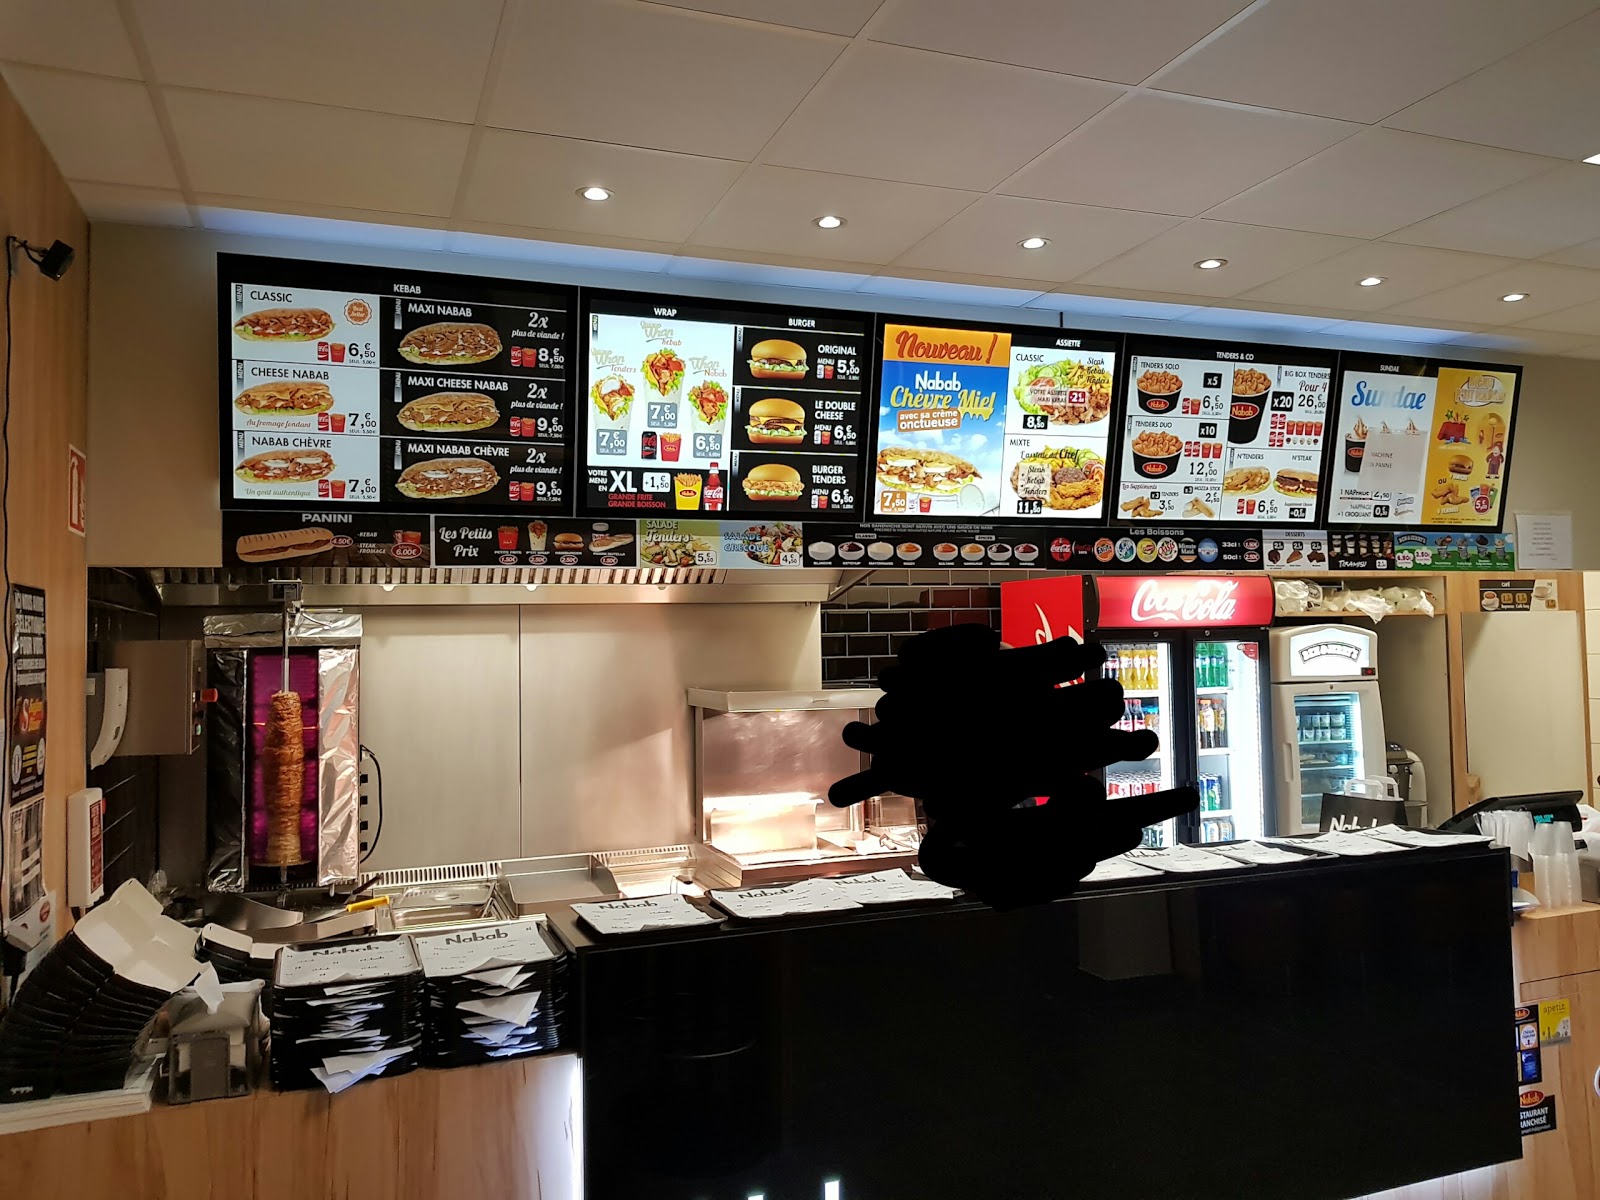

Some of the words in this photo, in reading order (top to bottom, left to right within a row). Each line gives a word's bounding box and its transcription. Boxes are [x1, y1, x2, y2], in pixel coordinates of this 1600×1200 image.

[393, 284, 421, 294] KEBAB
[250, 290, 292, 303] CLASSIC
[408, 303, 434, 315] MAXI
[437, 305, 472, 318] NABAB
[654, 307, 677, 317] WRAP
[788, 318, 816, 328] BURGER
[511, 329, 526, 338] plus
[528, 330, 536, 338] de
[536, 330, 560, 340] viande
[896, 330, 982, 361] Nouveau
[986, 334, 998, 364] !
[1055, 338, 1081, 347] ASSIETTE
[818, 344, 857, 356] ORIGINAL
[1016, 354, 1044, 362] CLASSIC
[1216, 351, 1239, 360] TENDERS
[251, 367, 289, 378] CHEESE
[292, 369, 330, 380] NABAB
[610, 365, 636, 374] Tenders
[408, 376, 434, 387] MAXI
[436, 378, 472, 390] CHEESE
[474, 380, 508, 392] NABAB
[915, 370, 962, 391] Nabab
[1207, 376, 1218, 386] x5
[1298, 380, 1319, 392] Pour
[1322, 382, 1328, 392] 4
[890, 386, 952, 409] Chèvre
[958, 389, 997, 410] Miel
[1272, 396, 1292, 408] x20
[510, 400, 526, 409] plus
[536, 401, 558, 410] viande
[815, 400, 824, 409] LE
[825, 401, 856, 411] DOUBLE
[815, 410, 844, 420] CHEESE
[920, 411, 930, 420] sa
[932, 410, 958, 418] crème
[255, 420, 286, 428] fromage
[900, 418, 958, 430] onctueuse
[1200, 426, 1216, 436] x10
[252, 437, 289, 447] NABAB
[292, 436, 332, 448] CHÈVRE
[1010, 438, 1030, 446] MIXTE
[408, 443, 434, 454] MAXI
[436, 444, 471, 456] NABAB
[474, 444, 510, 456] CHÈVRE
[1060, 448, 1080, 462] Chef
[510, 466, 525, 474] plus
[535, 466, 558, 474] viande
[812, 465, 844, 474] BURGER
[608, 470, 638, 492] XL
[812, 475, 846, 484] TENDERS
[273, 489, 312, 497] authentique
[302, 514, 352, 524] PANINI
[646, 521, 678, 530] SALADE
[439, 526, 457, 542] Les
[459, 526, 492, 540] Petits
[647, 530, 691, 543] Tenders
[724, 532, 762, 541] SALADE
[454, 544, 479, 558] Prix
[724, 544, 770, 552] GRECQUE
[1338, 560, 1368, 568] TIRAMISU
[1130, 580, 1239, 622] Coca-Cola
[835, 876, 886, 886] Nabab
[738, 888, 794, 900] Nabab
[599, 900, 658, 910] Nabab
[446, 929, 508, 946] Nabab
[312, 945, 380, 956] Nabab
